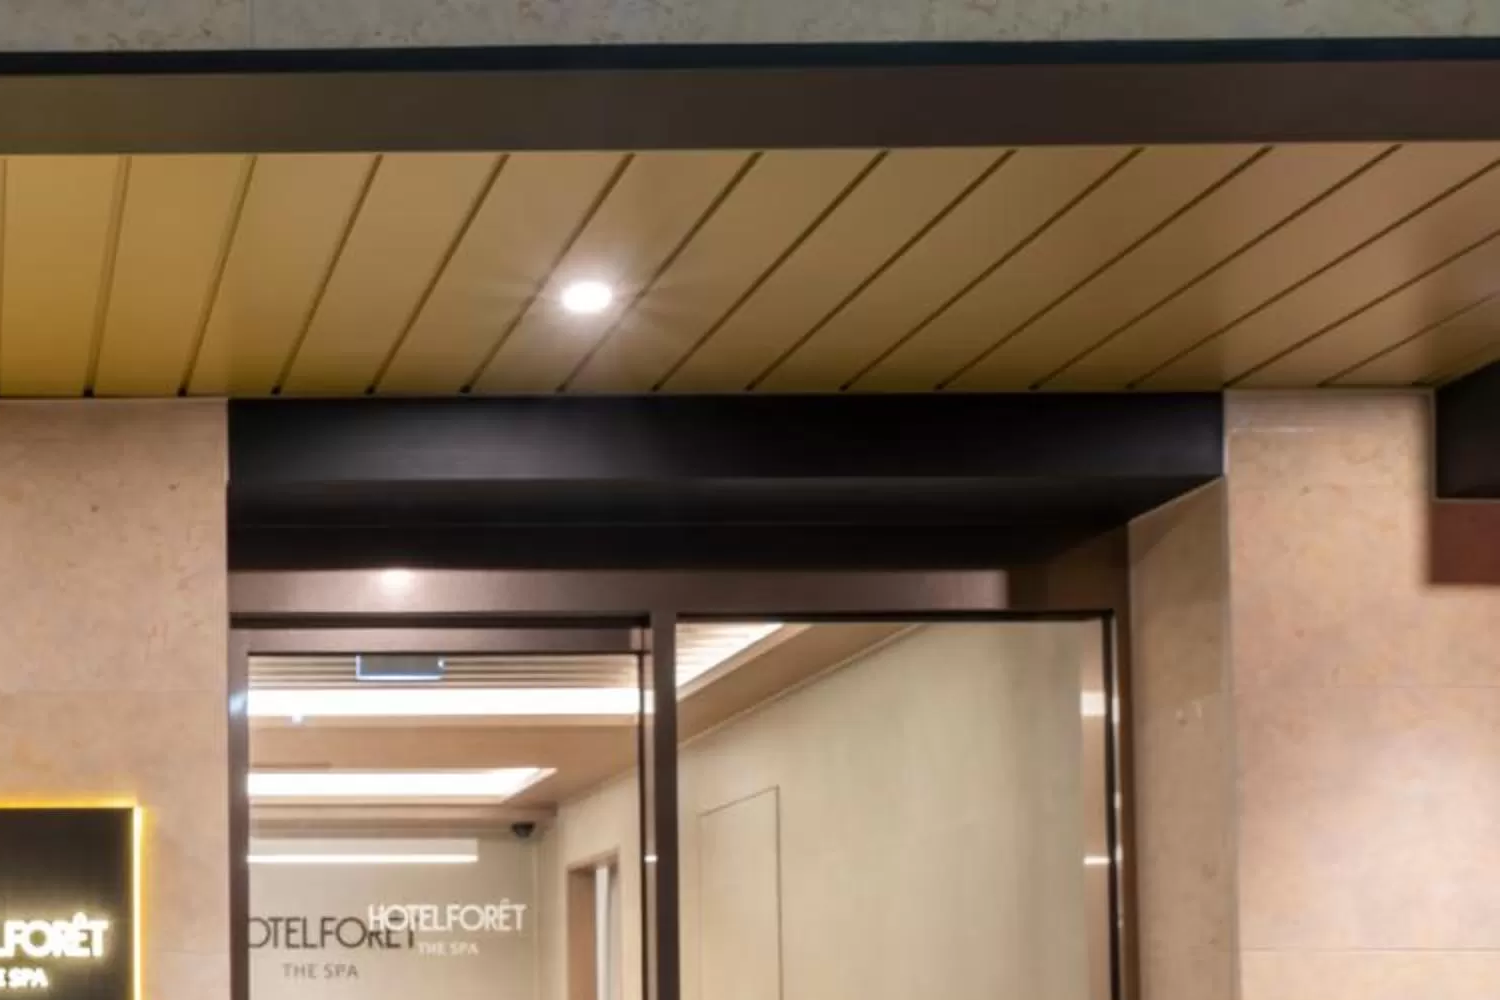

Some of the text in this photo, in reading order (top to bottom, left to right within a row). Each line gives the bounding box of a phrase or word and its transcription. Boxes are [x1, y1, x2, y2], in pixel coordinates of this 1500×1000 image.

[367, 898, 527, 931] HOTELFORÊT
[418, 941, 479, 956] THE SPA
[7, 967, 48, 987] SPA
[282, 963, 359, 979] THE SPA
